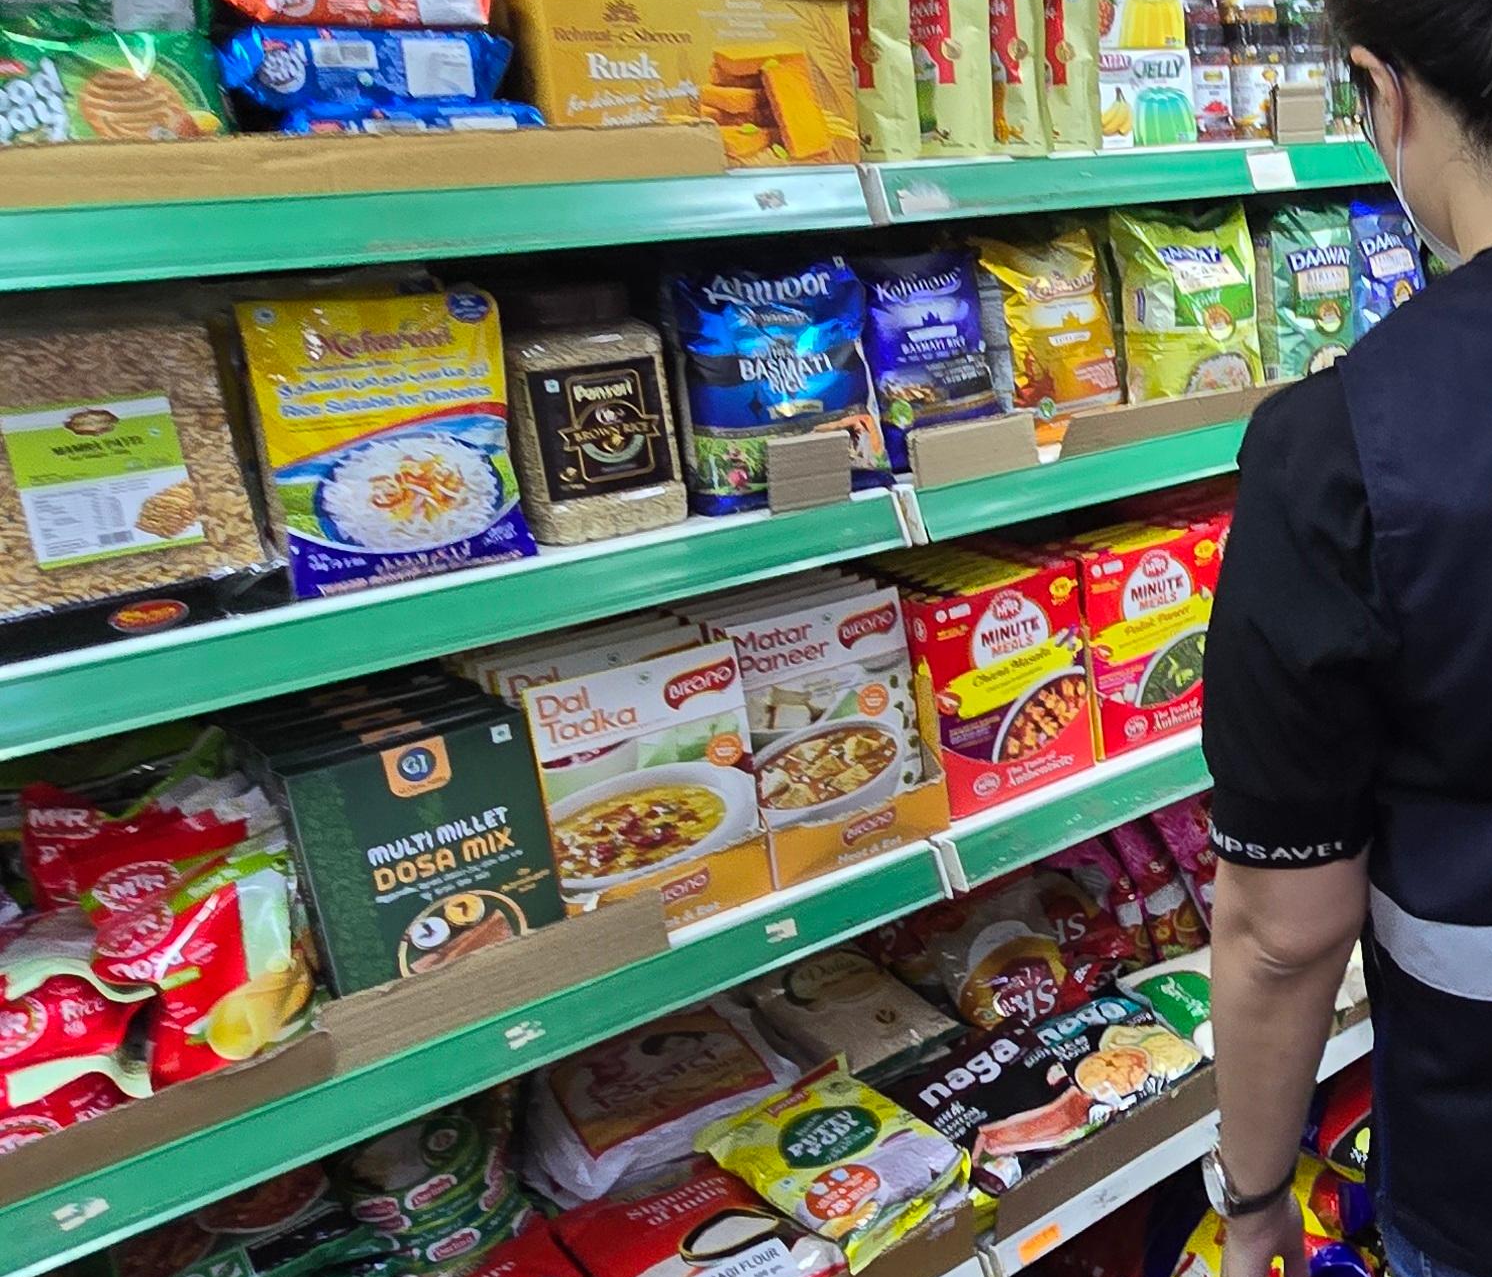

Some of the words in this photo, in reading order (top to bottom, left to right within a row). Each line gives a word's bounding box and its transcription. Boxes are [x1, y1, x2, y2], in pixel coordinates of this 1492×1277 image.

[586, 51, 662, 82] Rusk
[1134, 58, 1183, 79] JELLY
[1130, 577, 1186, 603] MINUTE
[980, 615, 1042, 649] MINUTE
[990, 632, 1036, 658] MEALS
[740, 638, 830, 673] Paneer
[535, 685, 590, 722] Dal
[543, 704, 639, 743] Tadka
[366, 831, 433, 867] MULTI
[435, 805, 509, 847] MILLET
[372, 853, 458, 893] DOSA
[461, 826, 516, 865] MIX
[917, 1035, 1021, 1108] naga
